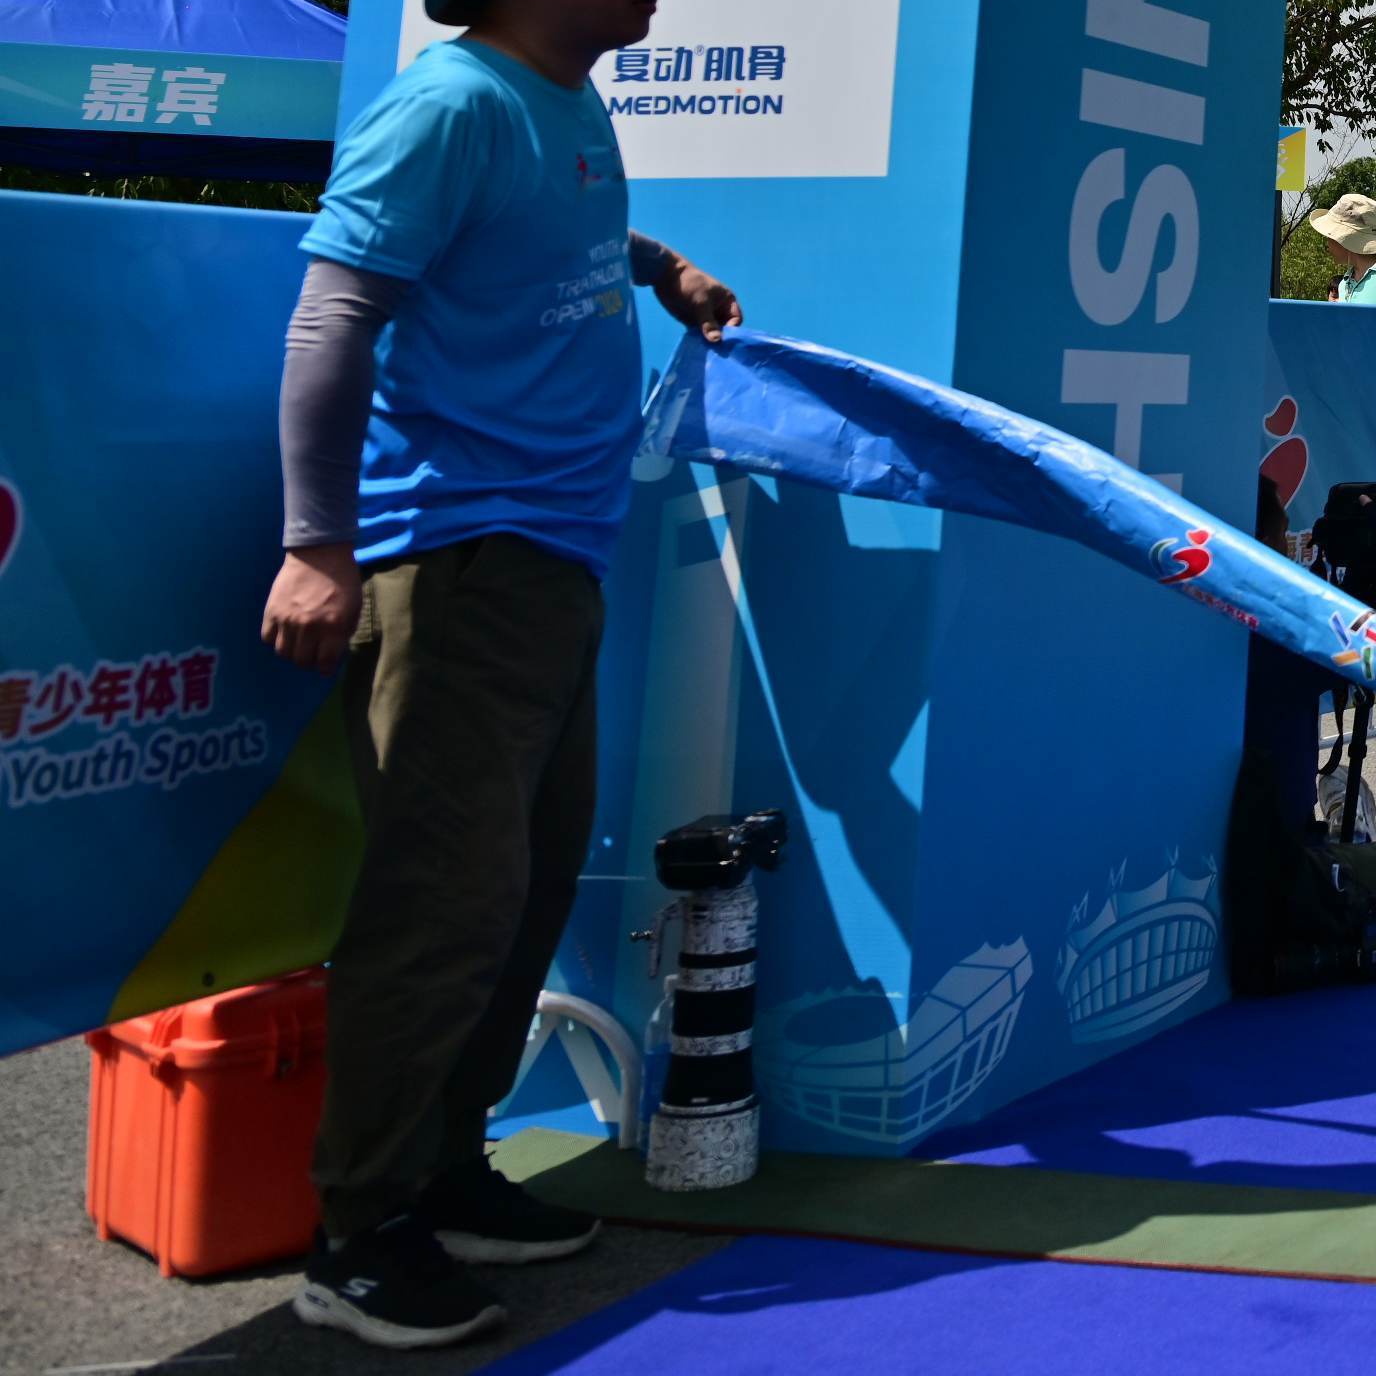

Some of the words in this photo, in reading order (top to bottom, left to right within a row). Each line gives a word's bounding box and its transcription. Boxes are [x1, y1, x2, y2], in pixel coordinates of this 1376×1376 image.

[80, 62, 227, 126] 嘉宾
[608, 88, 784, 117] MEDMOTION
[540, 296, 594, 327] OPEN
[8, 734, 136, 805] Youth
[146, 720, 266, 788] Sports
